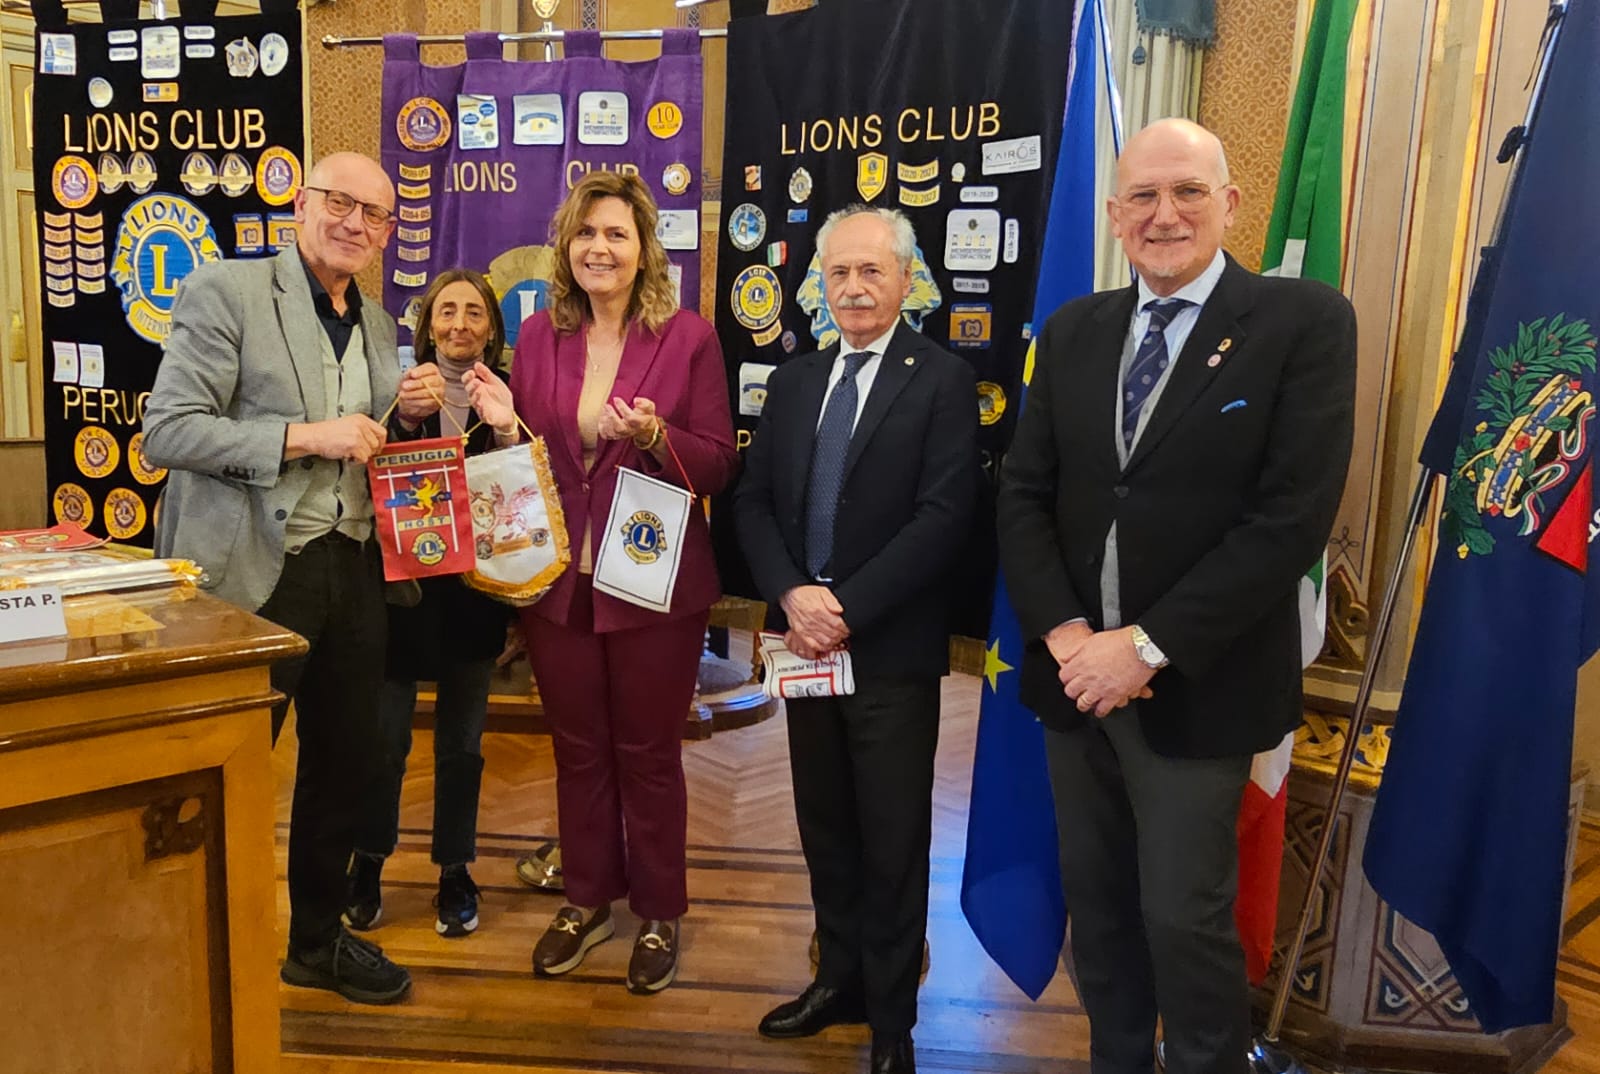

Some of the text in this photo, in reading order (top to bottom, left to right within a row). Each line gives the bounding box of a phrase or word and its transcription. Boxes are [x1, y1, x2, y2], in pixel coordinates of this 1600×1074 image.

[64, 108, 266, 152] LIONS CLUB
[658, 106, 675, 123] 10
[781, 102, 1001, 155] LIONS CLUB
[444, 160, 518, 193] LIONS
[131, 201, 200, 233] LIONS
[149, 244, 179, 296] L
[375, 448, 457, 468] PERUGIA
[404, 516, 445, 529] HOST
[0, 594, 57, 610] STA P.
